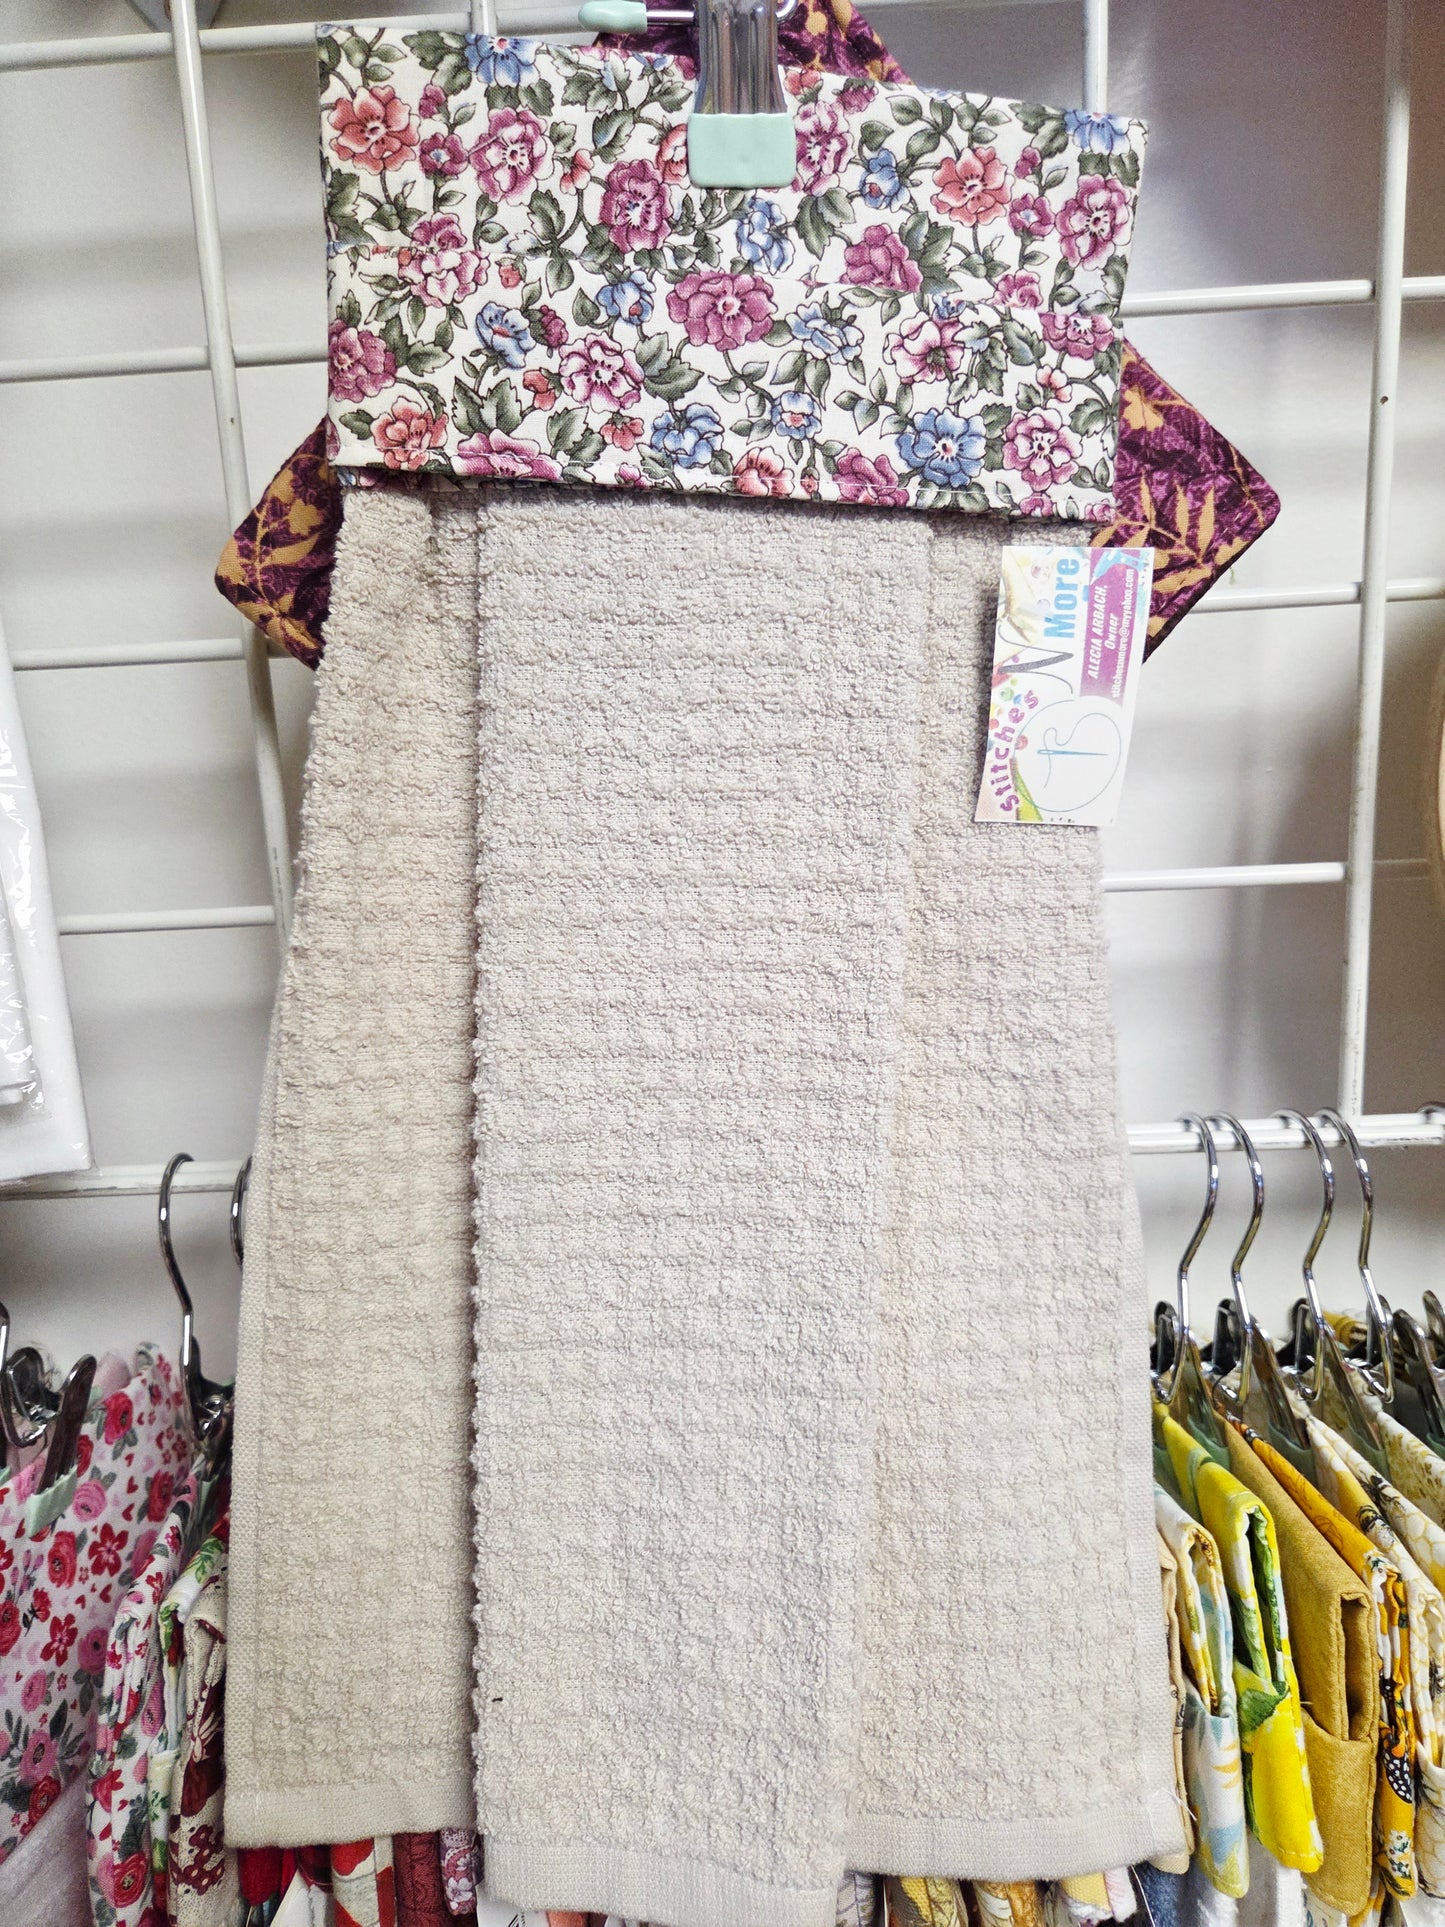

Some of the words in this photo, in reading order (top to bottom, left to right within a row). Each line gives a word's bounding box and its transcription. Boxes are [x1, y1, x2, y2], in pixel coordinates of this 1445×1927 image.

[998, 623, 1074, 694] N
[1043, 558, 1080, 638] More
[1104, 612, 1119, 650] Owner
[1087, 636, 1103, 680] ALECIA
